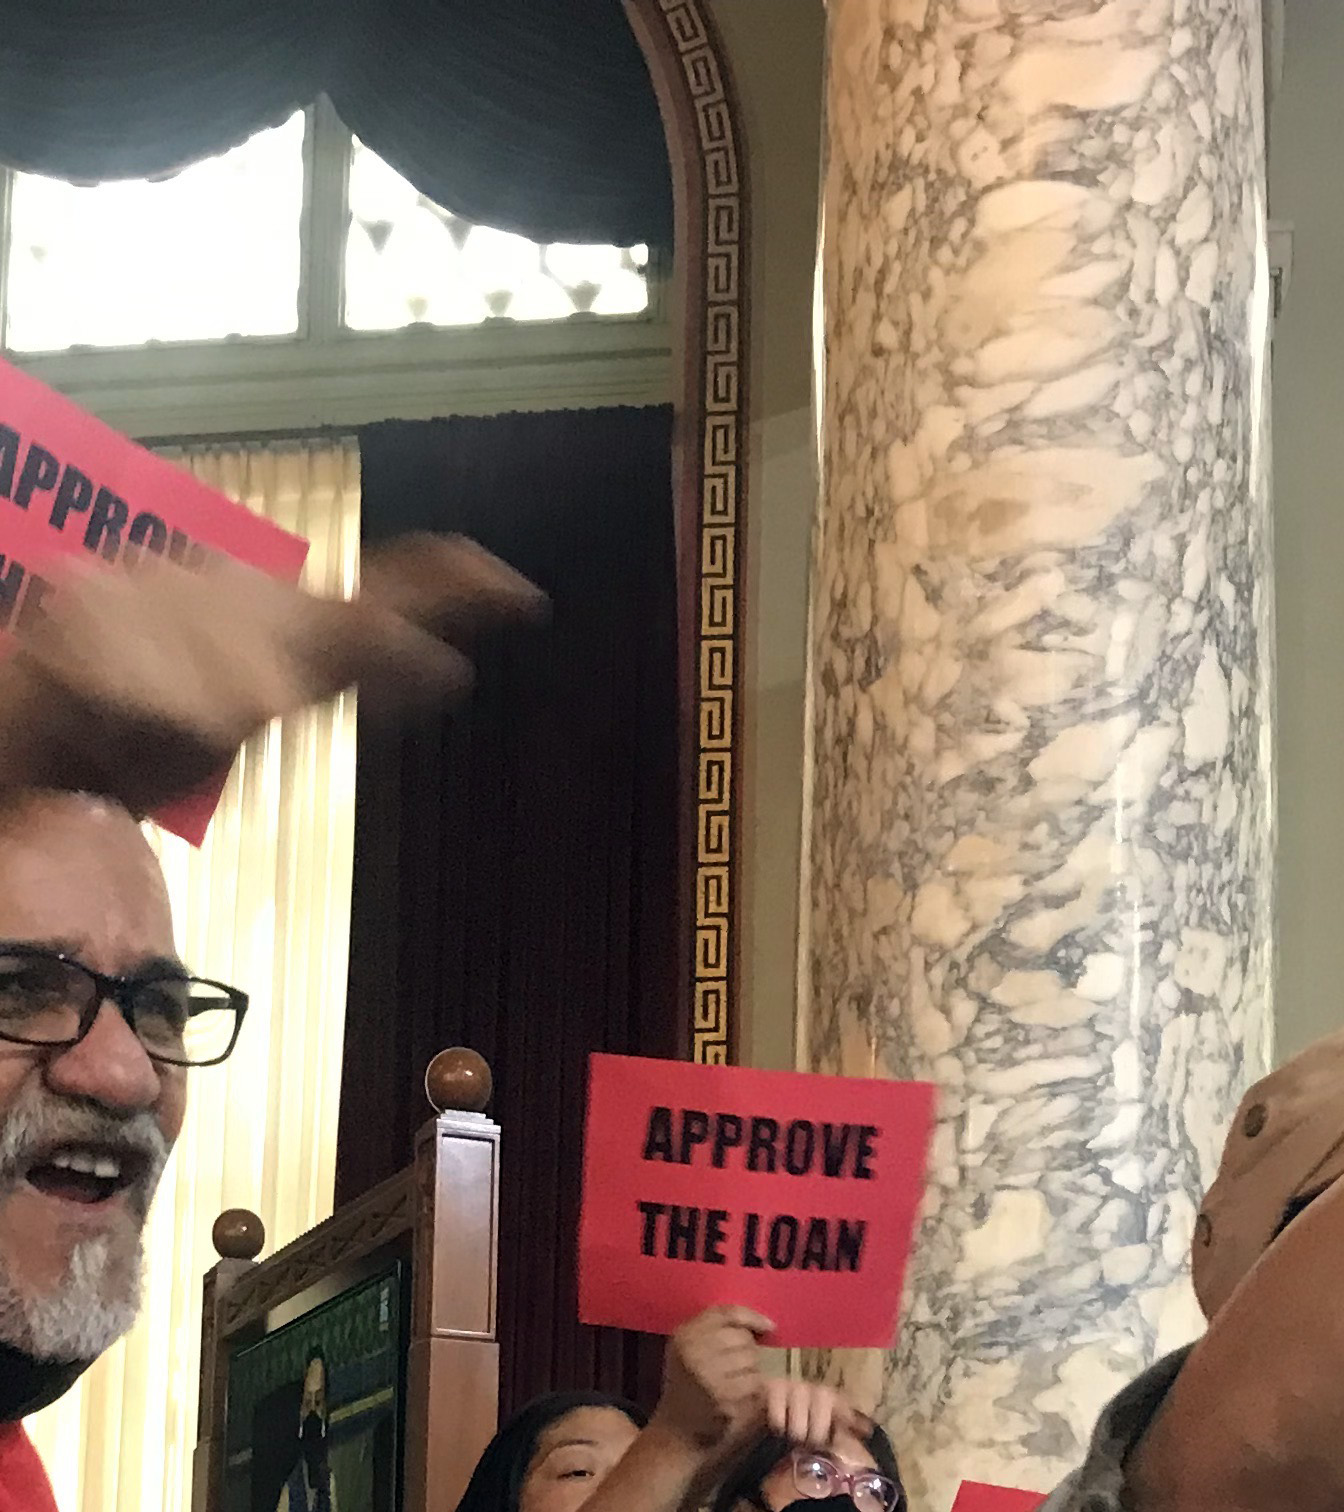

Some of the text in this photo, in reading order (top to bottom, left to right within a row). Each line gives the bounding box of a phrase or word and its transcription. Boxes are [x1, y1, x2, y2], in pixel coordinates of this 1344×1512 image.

[641, 1105, 883, 1180] APPROVE
[637, 1199, 869, 1273] THE LOAN
